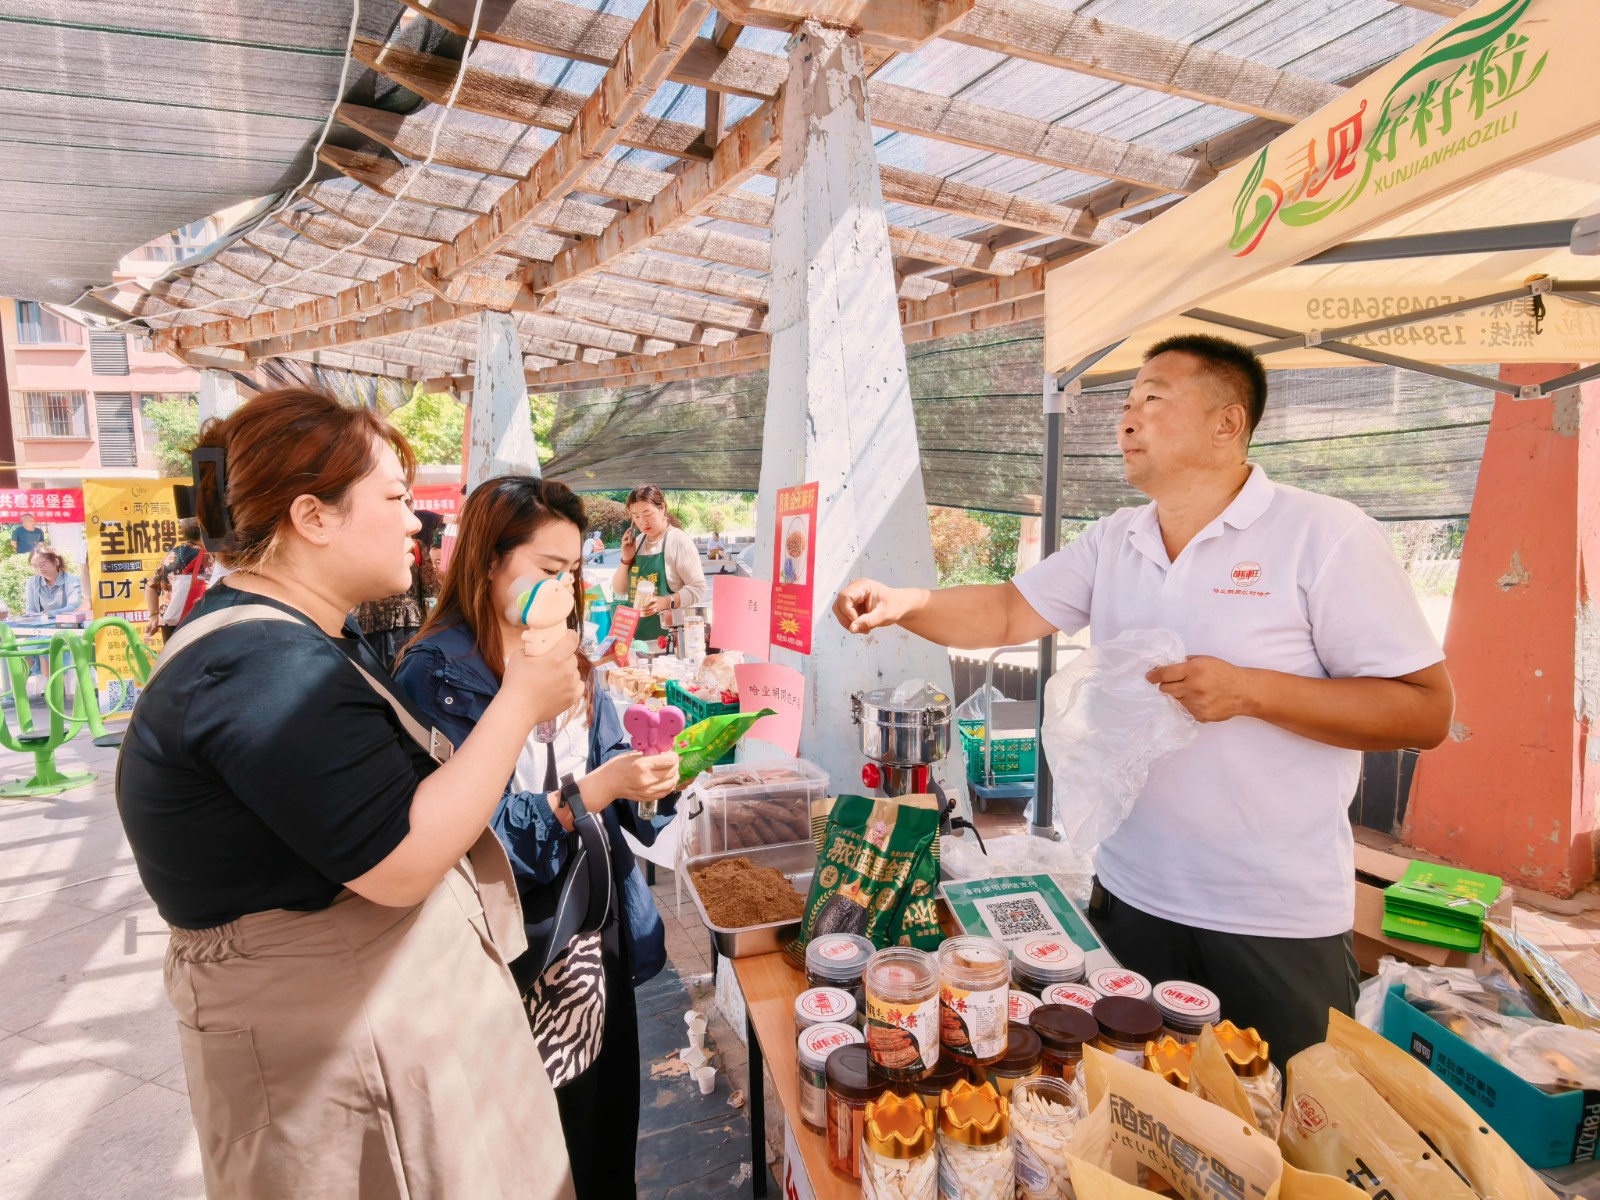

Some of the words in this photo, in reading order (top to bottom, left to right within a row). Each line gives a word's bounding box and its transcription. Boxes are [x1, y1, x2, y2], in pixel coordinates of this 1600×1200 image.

[1374, 110, 1518, 195] XUNJIANHAOZILI
[99, 519, 185, 555] 全城搜
